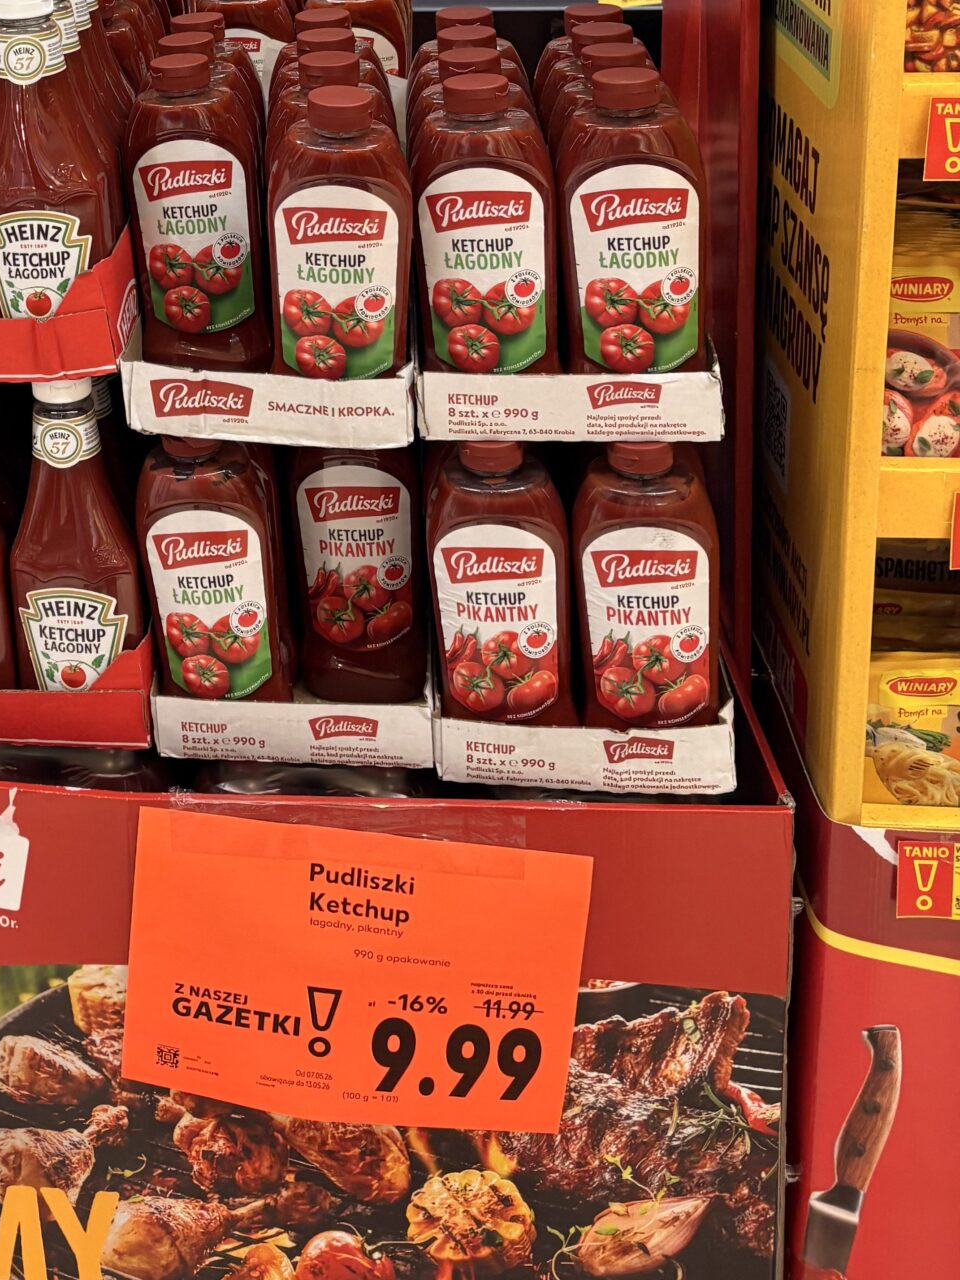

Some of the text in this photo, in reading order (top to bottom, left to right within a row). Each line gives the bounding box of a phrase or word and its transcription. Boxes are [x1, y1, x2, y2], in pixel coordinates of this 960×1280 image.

[936, 103, 960, 115] TAN
[147, 166, 227, 194] Pudliszki
[162, 204, 218, 219] KETCHUP
[435, 196, 526, 227] Pudliszki
[590, 193, 682, 225] Pudliszki
[5, 223, 62, 243] HEINZ
[157, 215, 228, 236] ŁAGODNY
[290, 212, 380, 241] Pudliszki
[451, 237, 514, 253] KETCHUP
[607, 235, 671, 251] KETCHUP
[2, 251, 71, 267] KETCHUP
[305, 252, 367, 269] KETCHUP
[443, 251, 523, 270] ŁAGODNY
[599, 247, 679, 269] ŁAGODNY
[8, 266, 66, 280] ŁAGODNY
[297, 263, 375, 284] ŁAGODNY
[781, 205, 830, 342] SZANSĘ
[891, 282, 950, 297] WINIARY
[158, 382, 245, 418] Pudliszki
[448, 393, 498, 406] KETCHUP
[593, 383, 656, 401] Pudliszki
[267, 400, 329, 417] SMACZNE
[338, 404, 396, 418] KROPKA.
[448, 408, 539, 421] 8 szt. x 990 g
[49, 430, 71, 441] HEINZ
[50, 440, 70, 455] 57
[313, 490, 395, 518] Pudliszki
[328, 528, 385, 542] KETCHUP
[161, 537, 243, 566] Pudliszki
[319, 539, 396, 557] PIKANTNY
[450, 551, 536, 578] Pudliszki
[601, 554, 691, 582] Pudliszki
[177, 574, 234, 590] KETCHUP
[172, 585, 244, 605] ŁAGODNY
[466, 590, 526, 606] KETCHUP
[617, 595, 680, 609] KETCHUP
[456, 603, 539, 623] PIKANTNY
[606, 606, 692, 626] PIKANTNY
[896, 679, 955, 693] WINIARY
[181, 721, 228, 734] KETCHUP
[315, 718, 374, 735] Pudliszki
[466, 741, 516, 755] KETCHUP
[609, 744, 669, 760] Pudliszki
[904, 846, 949, 858] TANIO
[310, 863, 415, 895] Pudliszki
[310, 892, 410, 927] Ketchup
[310, 918, 404, 938] łagodny, pikantny
[354, 949, 451, 967] 990 g opakowanie
[175, 983, 248, 1006] Z NASZEJ
[388, 994, 448, 1014] -16%
[482, 999, 535, 1020] 11.99
[172, 997, 301, 1036] GAZETKI
[371, 1017, 542, 1102] 9.99
[296, 1070, 305, 1078] Od
